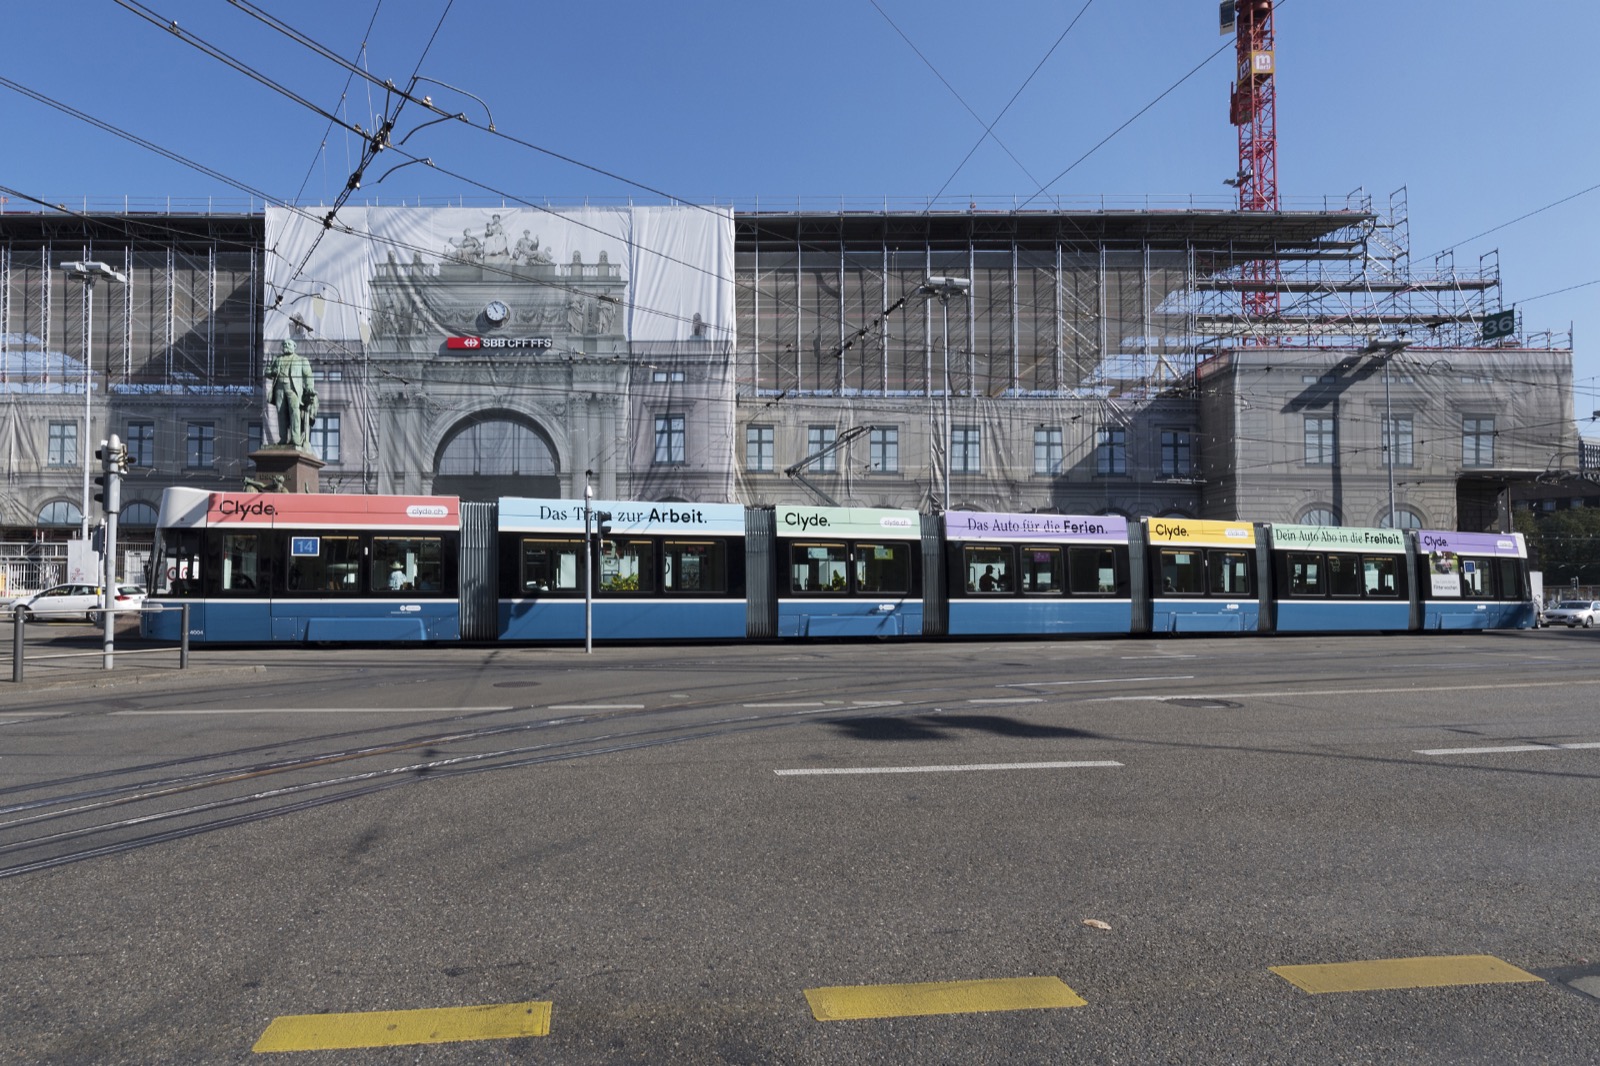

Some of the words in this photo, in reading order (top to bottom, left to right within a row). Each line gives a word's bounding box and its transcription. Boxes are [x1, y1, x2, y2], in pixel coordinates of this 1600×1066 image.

[1484, 316, 1513, 335] 36
[483, 338, 505, 347] SBB
[508, 338, 528, 347] CFF
[531, 338, 552, 347] FFS
[219, 500, 278, 521] Clyde.
[540, 505, 567, 521] Das
[617, 511, 643, 522] zur
[649, 508, 707, 524] Arbeit.
[785, 512, 831, 531] Clyde.
[968, 517, 989, 531] Das
[993, 518, 1019, 532] Auto
[1023, 519, 1040, 532] für
[1044, 520, 1060, 533] die
[1064, 520, 1109, 534] Ferien.
[1155, 523, 1190, 541] Clyde.
[1275, 528, 1297, 541] Dein
[1299, 530, 1319, 542] Auto
[1321, 530, 1338, 542] Abo
[1339, 531, 1349, 543] in
[1351, 532, 1363, 544] die
[297, 540, 313, 553] 14
[1424, 535, 1449, 550] Clyde.
